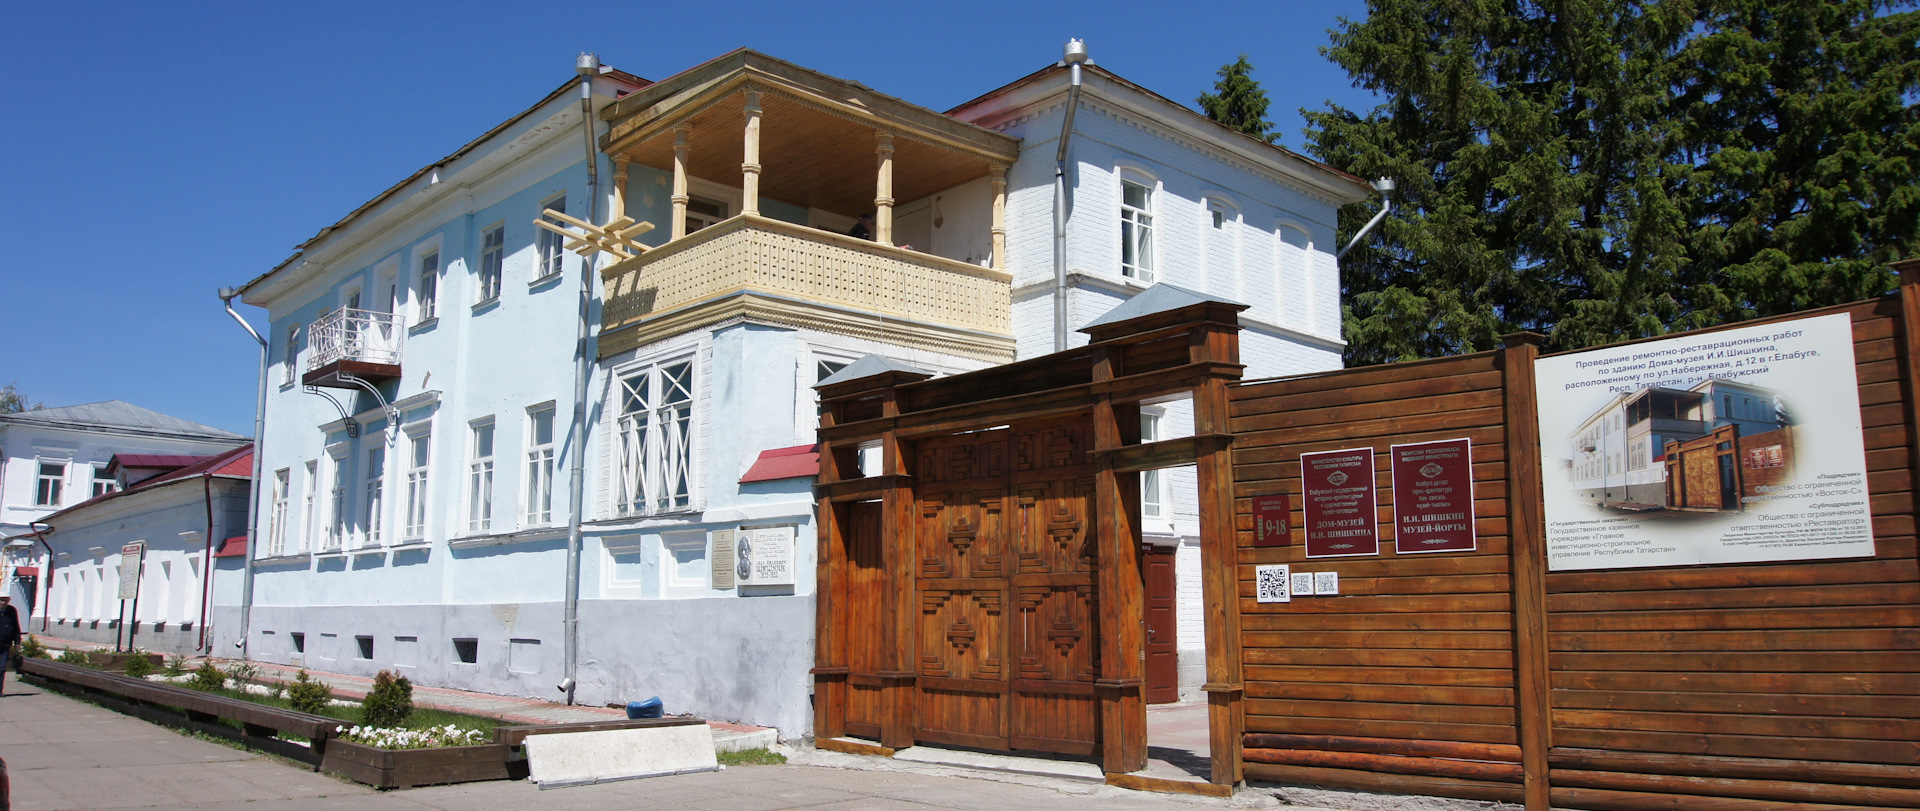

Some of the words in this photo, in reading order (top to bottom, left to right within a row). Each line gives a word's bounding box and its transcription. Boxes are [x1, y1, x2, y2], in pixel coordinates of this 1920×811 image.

[1576, 356, 1630, 369] Проведение
[1632, 336, 1770, 361] ремонтно-реставрационных
[1773, 330, 1803, 341] работ
[1612, 363, 1646, 373] зданию
[1648, 352, 1704, 369] Дома-музея
[1707, 344, 1778, 360] И.И.Шишкина,
[1565, 374, 1641, 390] расположенному
[1644, 371, 1654, 379] по
[1657, 362, 1733, 379] ул.Набережная,
[1736, 357, 1756, 367] д.12
[1768, 350, 1820, 362] г.Елабуге,
[1610, 385, 1632, 393] Респ.
[1805, 480, 1862, 490] ограниченной
[1422, 513, 1464, 522] ШИШКИН
[1758, 512, 1798, 521] Общество
[1807, 509, 1864, 519] ограниченной
[1266, 519, 1286, 536] 9-18
[1317, 517, 1364, 529] ДОМ-МУЗЕЙ
[1403, 523, 1466, 533] МУЗЕЙ-ЙОРТЫ
[1731, 522, 1801, 531] ответственностью
[1804, 518, 1865, 528] «Реставратор»
[1327, 529, 1372, 538] ШИШКИНА
[1550, 526, 1606, 534] Государственное
[1551, 535, 1590, 543] учреждение
[1551, 540, 1651, 550] инвестиционно-строительное
[1552, 550, 1590, 559] управление
[1595, 548, 1634, 556] Республики
